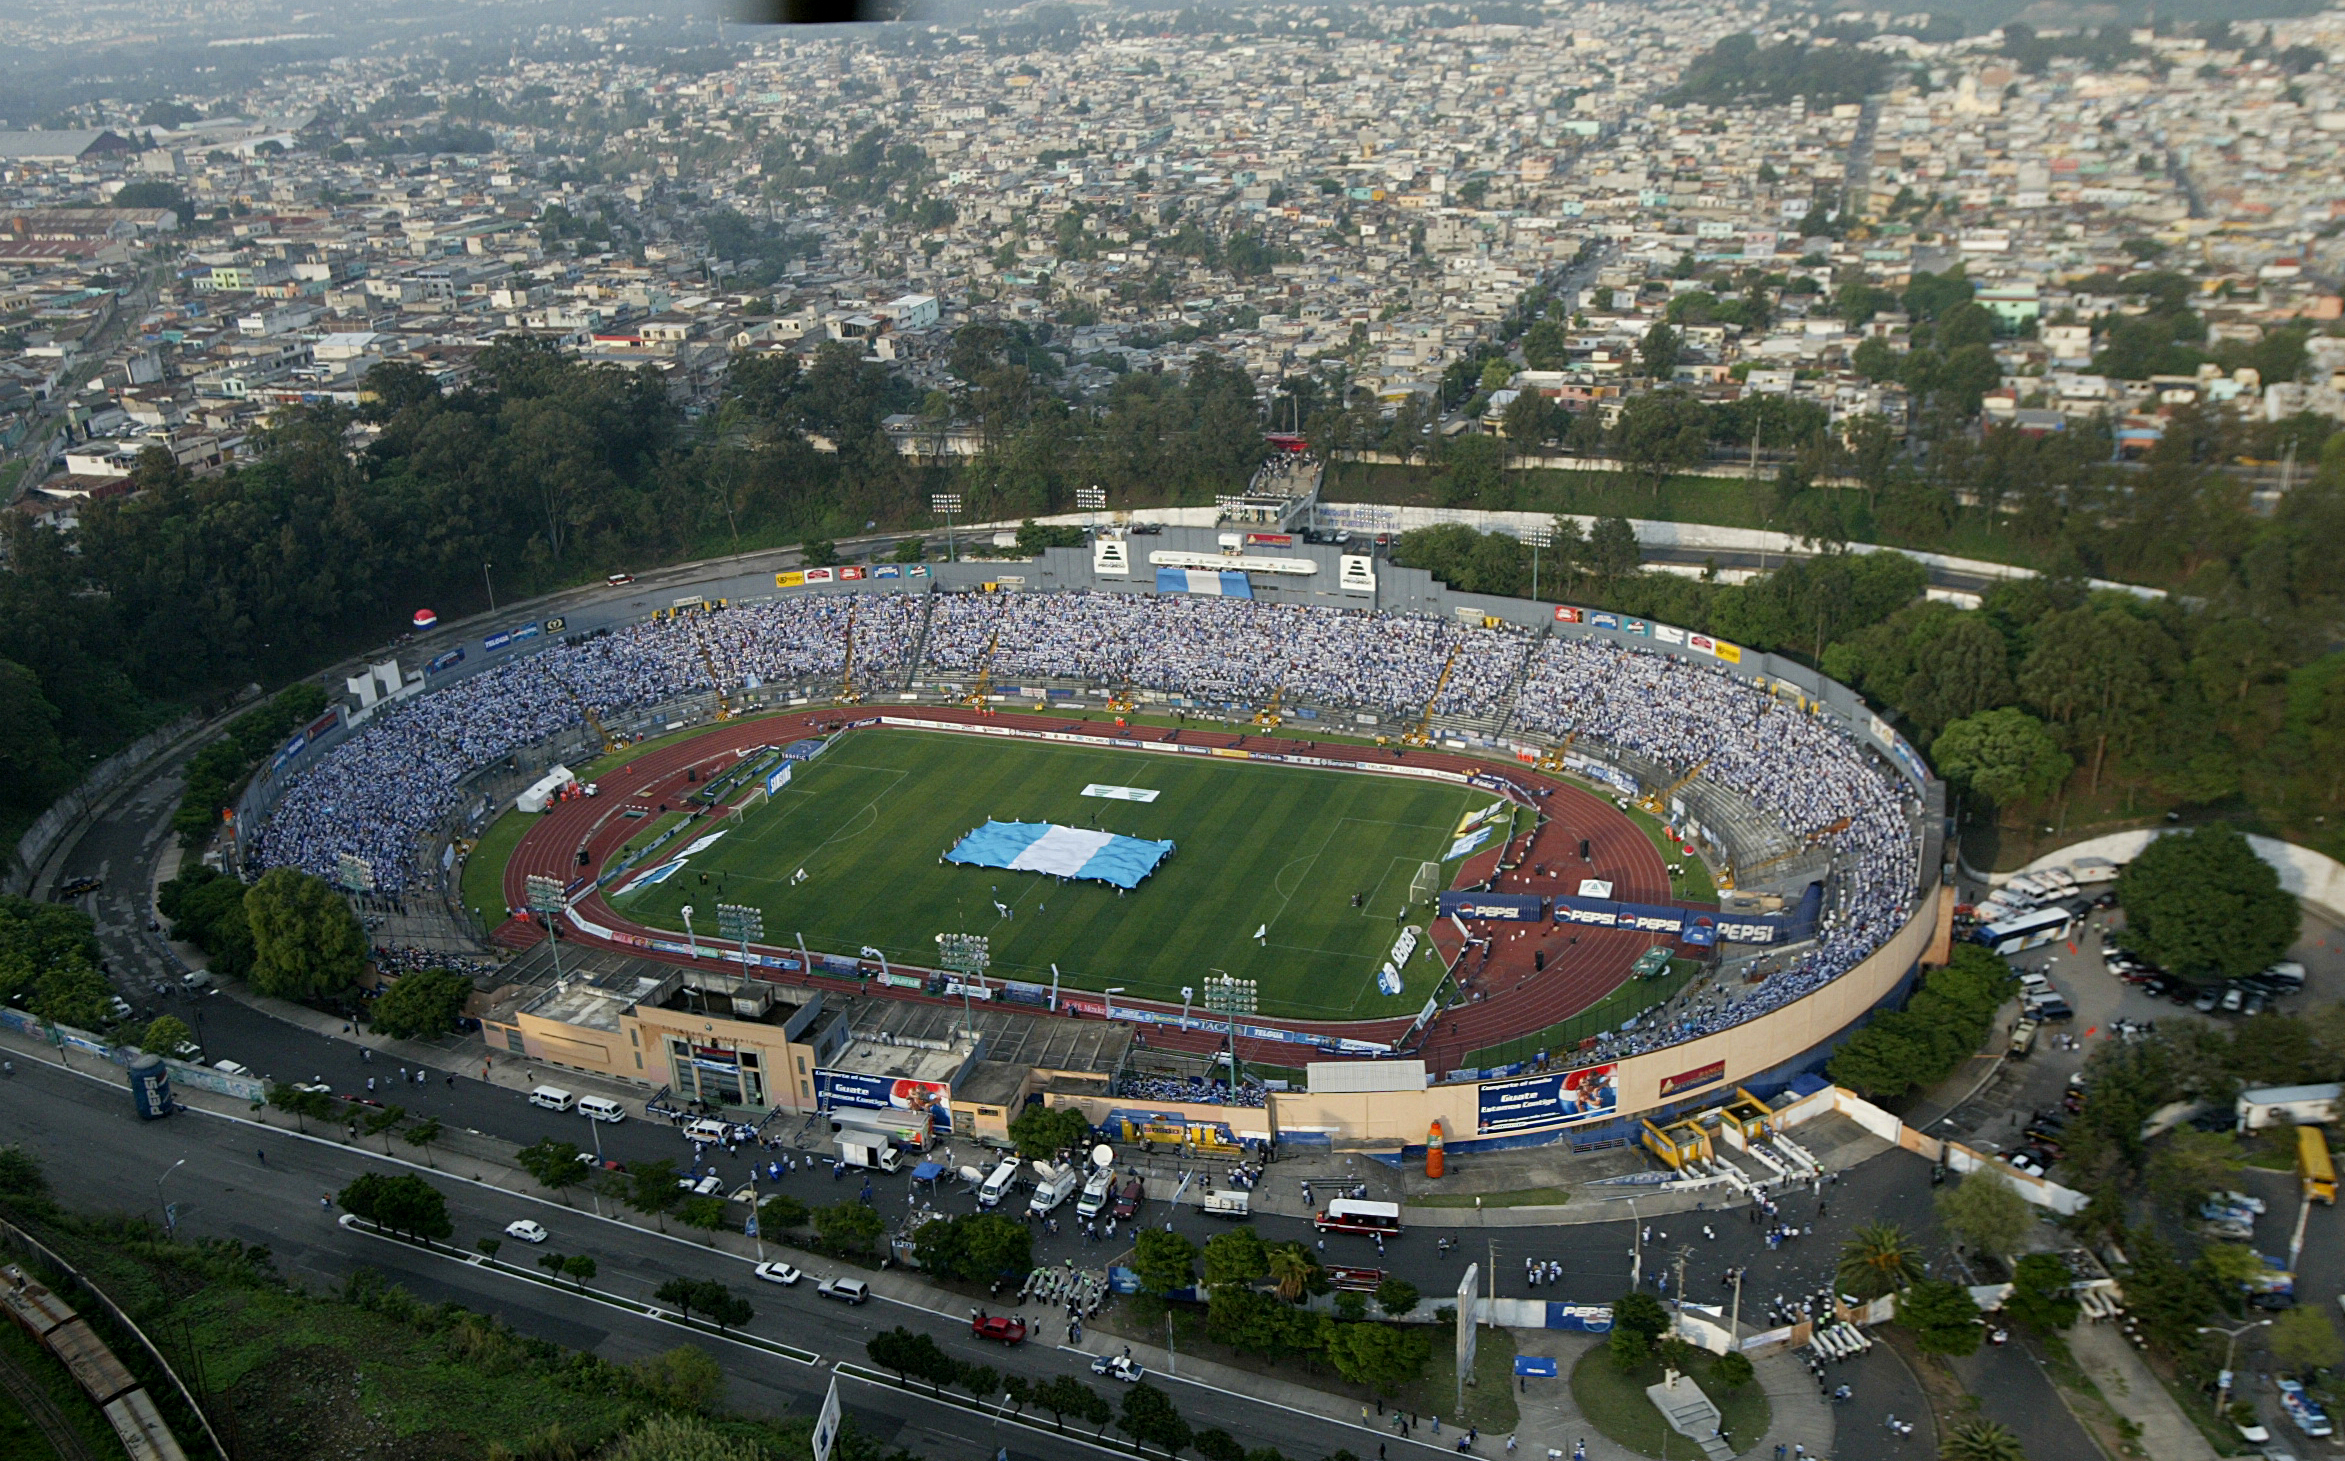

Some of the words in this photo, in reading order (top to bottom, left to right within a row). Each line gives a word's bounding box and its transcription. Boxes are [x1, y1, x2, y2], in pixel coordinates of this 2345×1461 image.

[1475, 905, 1520, 918] PEPSI
[1570, 910, 1617, 925] PEPSI
[1636, 917, 1682, 931] PEPSI
[1717, 922, 1774, 942] PEPSI
[1254, 1028, 1285, 1040] TELGUA
[143, 1076, 163, 1116] PEPSI
[835, 1084, 869, 1096] Guate
[1501, 1092, 1538, 1102] Guate
[1481, 1103, 1522, 1113] Estamos
[1522, 1098, 1557, 1108] Contigo
[1562, 1306, 1614, 1318] PEPS
